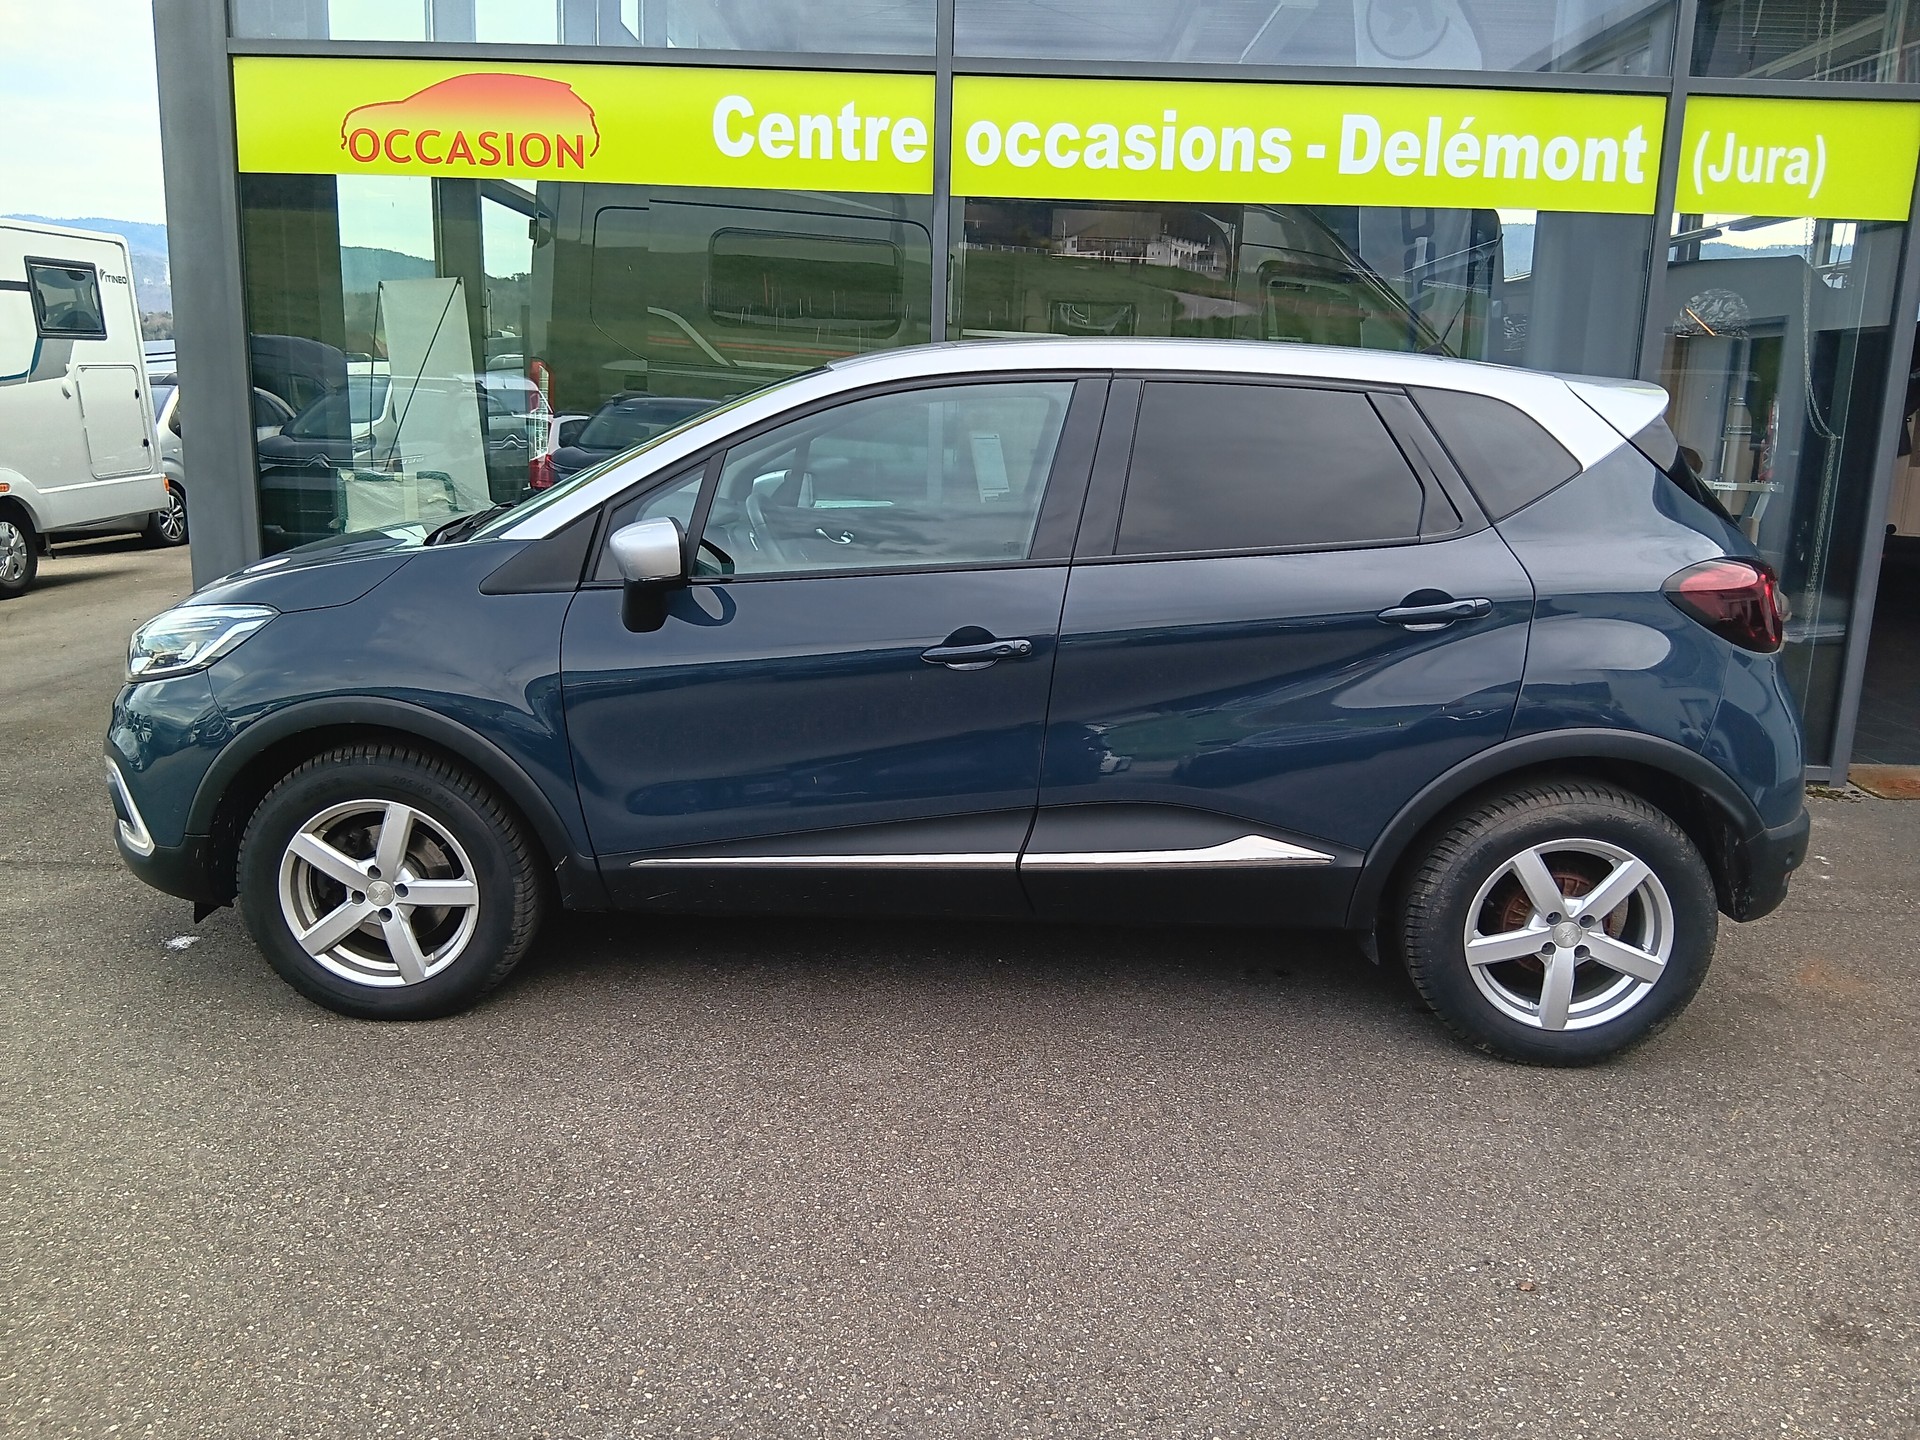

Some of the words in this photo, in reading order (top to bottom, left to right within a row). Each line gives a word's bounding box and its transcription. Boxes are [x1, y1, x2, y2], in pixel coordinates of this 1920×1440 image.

[349, 128, 585, 168] OCCASION
[712, 93, 928, 164] Centre
[965, 108, 1293, 174] occasions
[1306, 143, 1326, 159] -
[1338, 113, 1648, 185] Delémont
[1692, 130, 1827, 199] (Jura)
